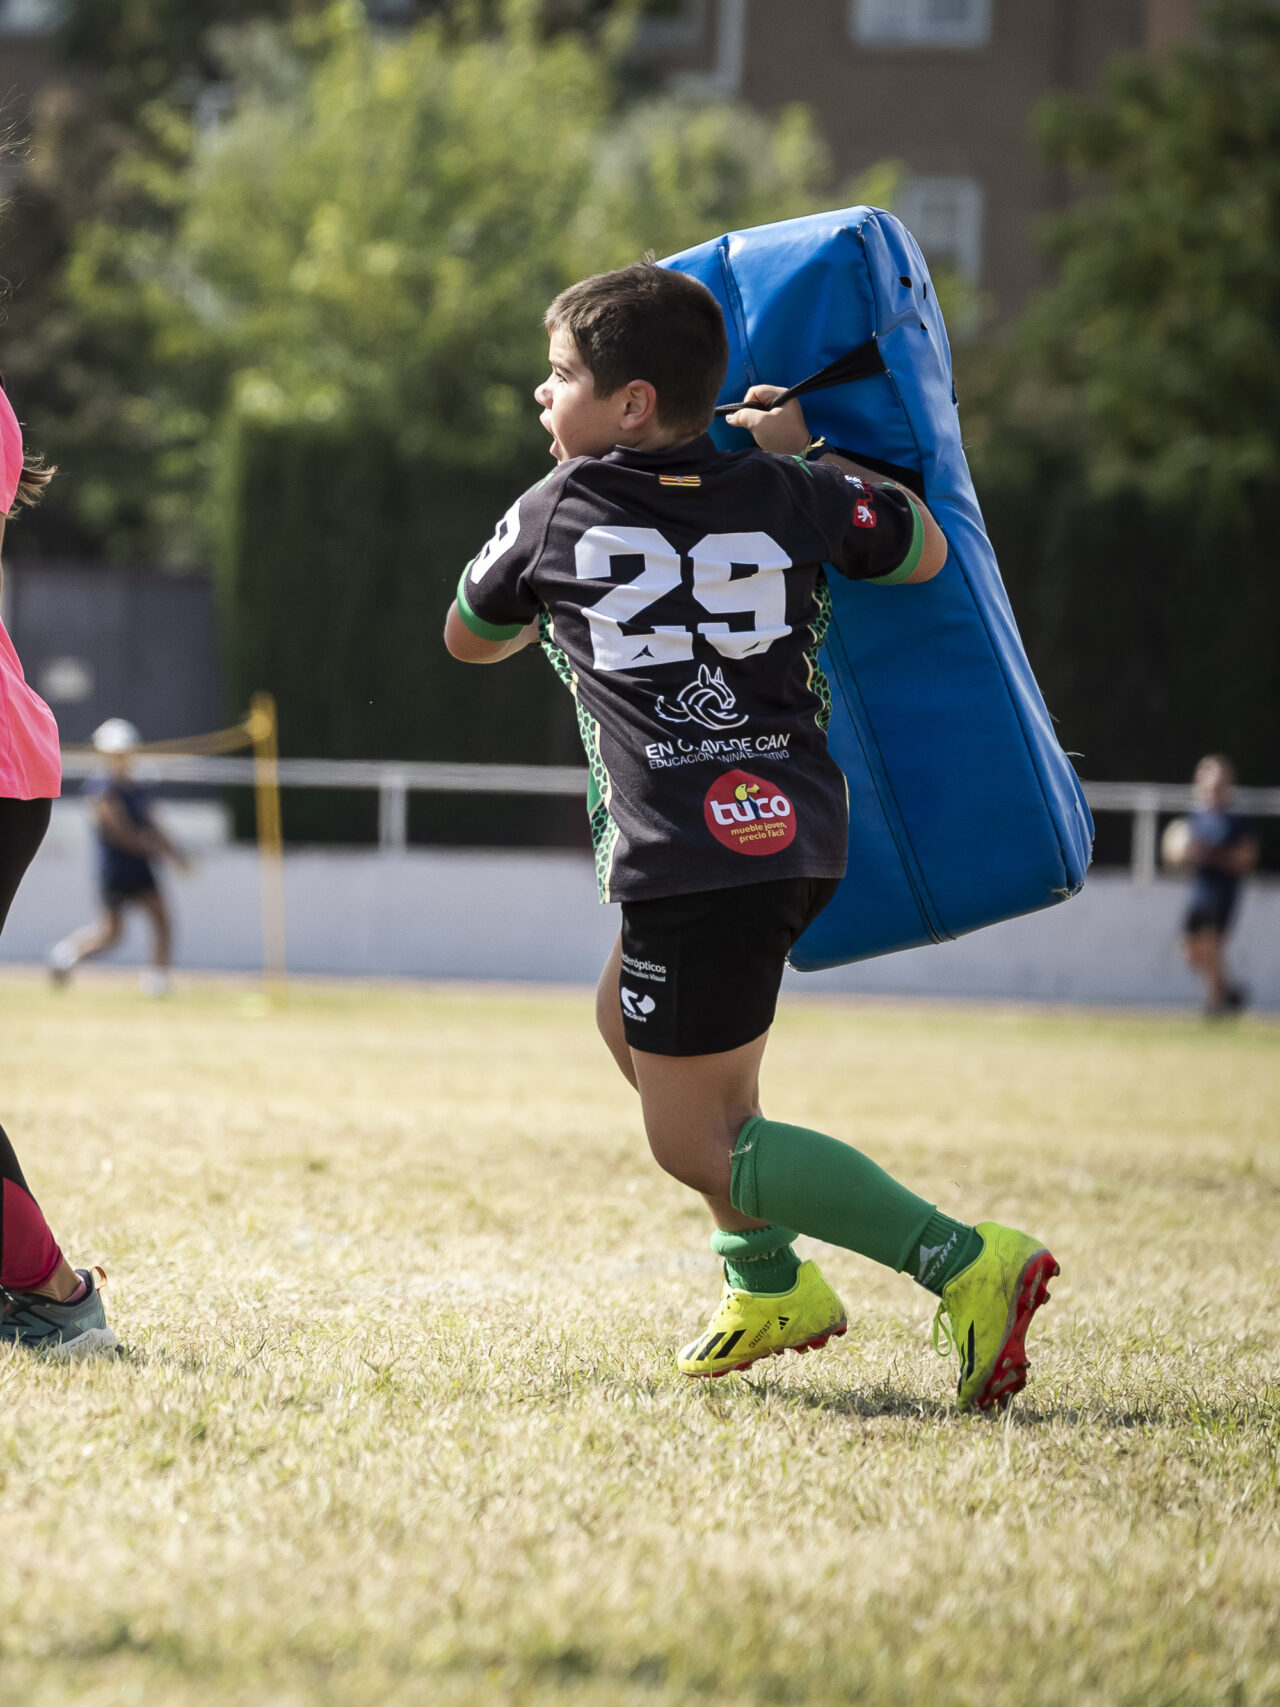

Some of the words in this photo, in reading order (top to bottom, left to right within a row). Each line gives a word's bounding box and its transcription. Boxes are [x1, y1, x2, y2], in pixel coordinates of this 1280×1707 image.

[574, 525, 793, 671] 29
[645, 740, 674, 759] EN
[755, 733, 790, 751] CAN
[730, 823, 763, 836] mueble
[739, 831, 767, 844] precio
